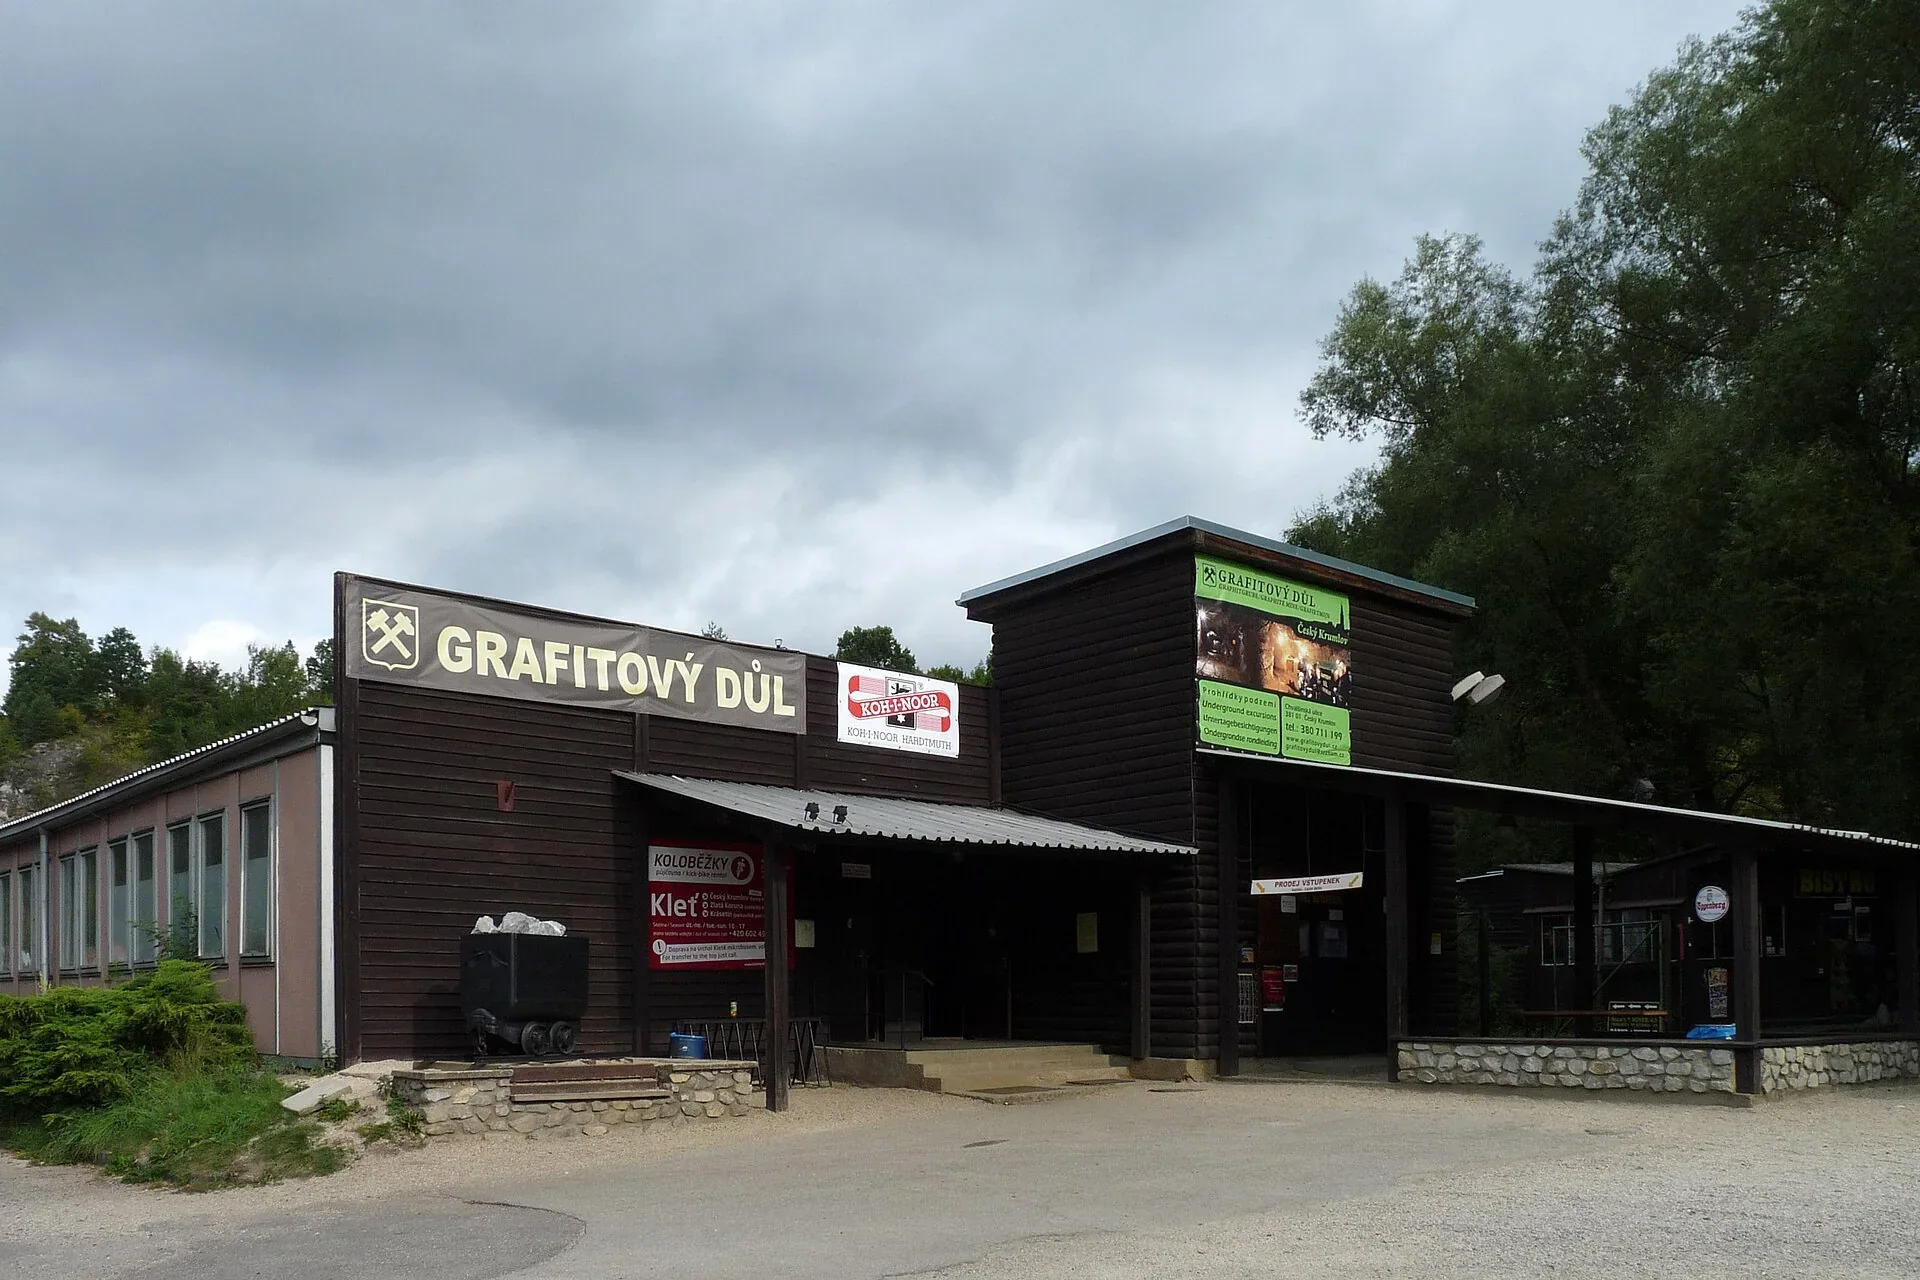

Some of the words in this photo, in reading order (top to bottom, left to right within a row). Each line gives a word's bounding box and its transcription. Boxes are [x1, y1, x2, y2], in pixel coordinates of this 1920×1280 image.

[1218, 569, 1290, 599] GRAFITOVÝ
[1292, 590, 1316, 608] DŮL
[1297, 619, 1318, 640] Český
[1318, 629, 1349, 646] Krumlov
[437, 625, 704, 703] GRAFITOVÝ
[716, 658, 796, 716] DŮL
[860, 693, 939, 717] KOH-I-NOOR
[1202, 700, 1245, 715] Underground
[1246, 709, 1277, 721] excursions
[1300, 724, 1314, 735] 380
[1316, 727, 1327, 738] 711
[1331, 730, 1342, 741] 199
[1318, 718, 1336, 727] Krumlov
[902, 734, 952, 750] HARDTMUTH
[1204, 727, 1246, 742] Ondergrondse
[1246, 736, 1278, 750] rondleiding
[654, 853, 729, 870] KOLOBĚŽKY
[1274, 879, 1300, 888] PRODEJ
[1302, 877, 1340, 886] VSTUPENEK
[1798, 868, 1876, 894] BISTRO
[651, 893, 699, 917] Kleť
